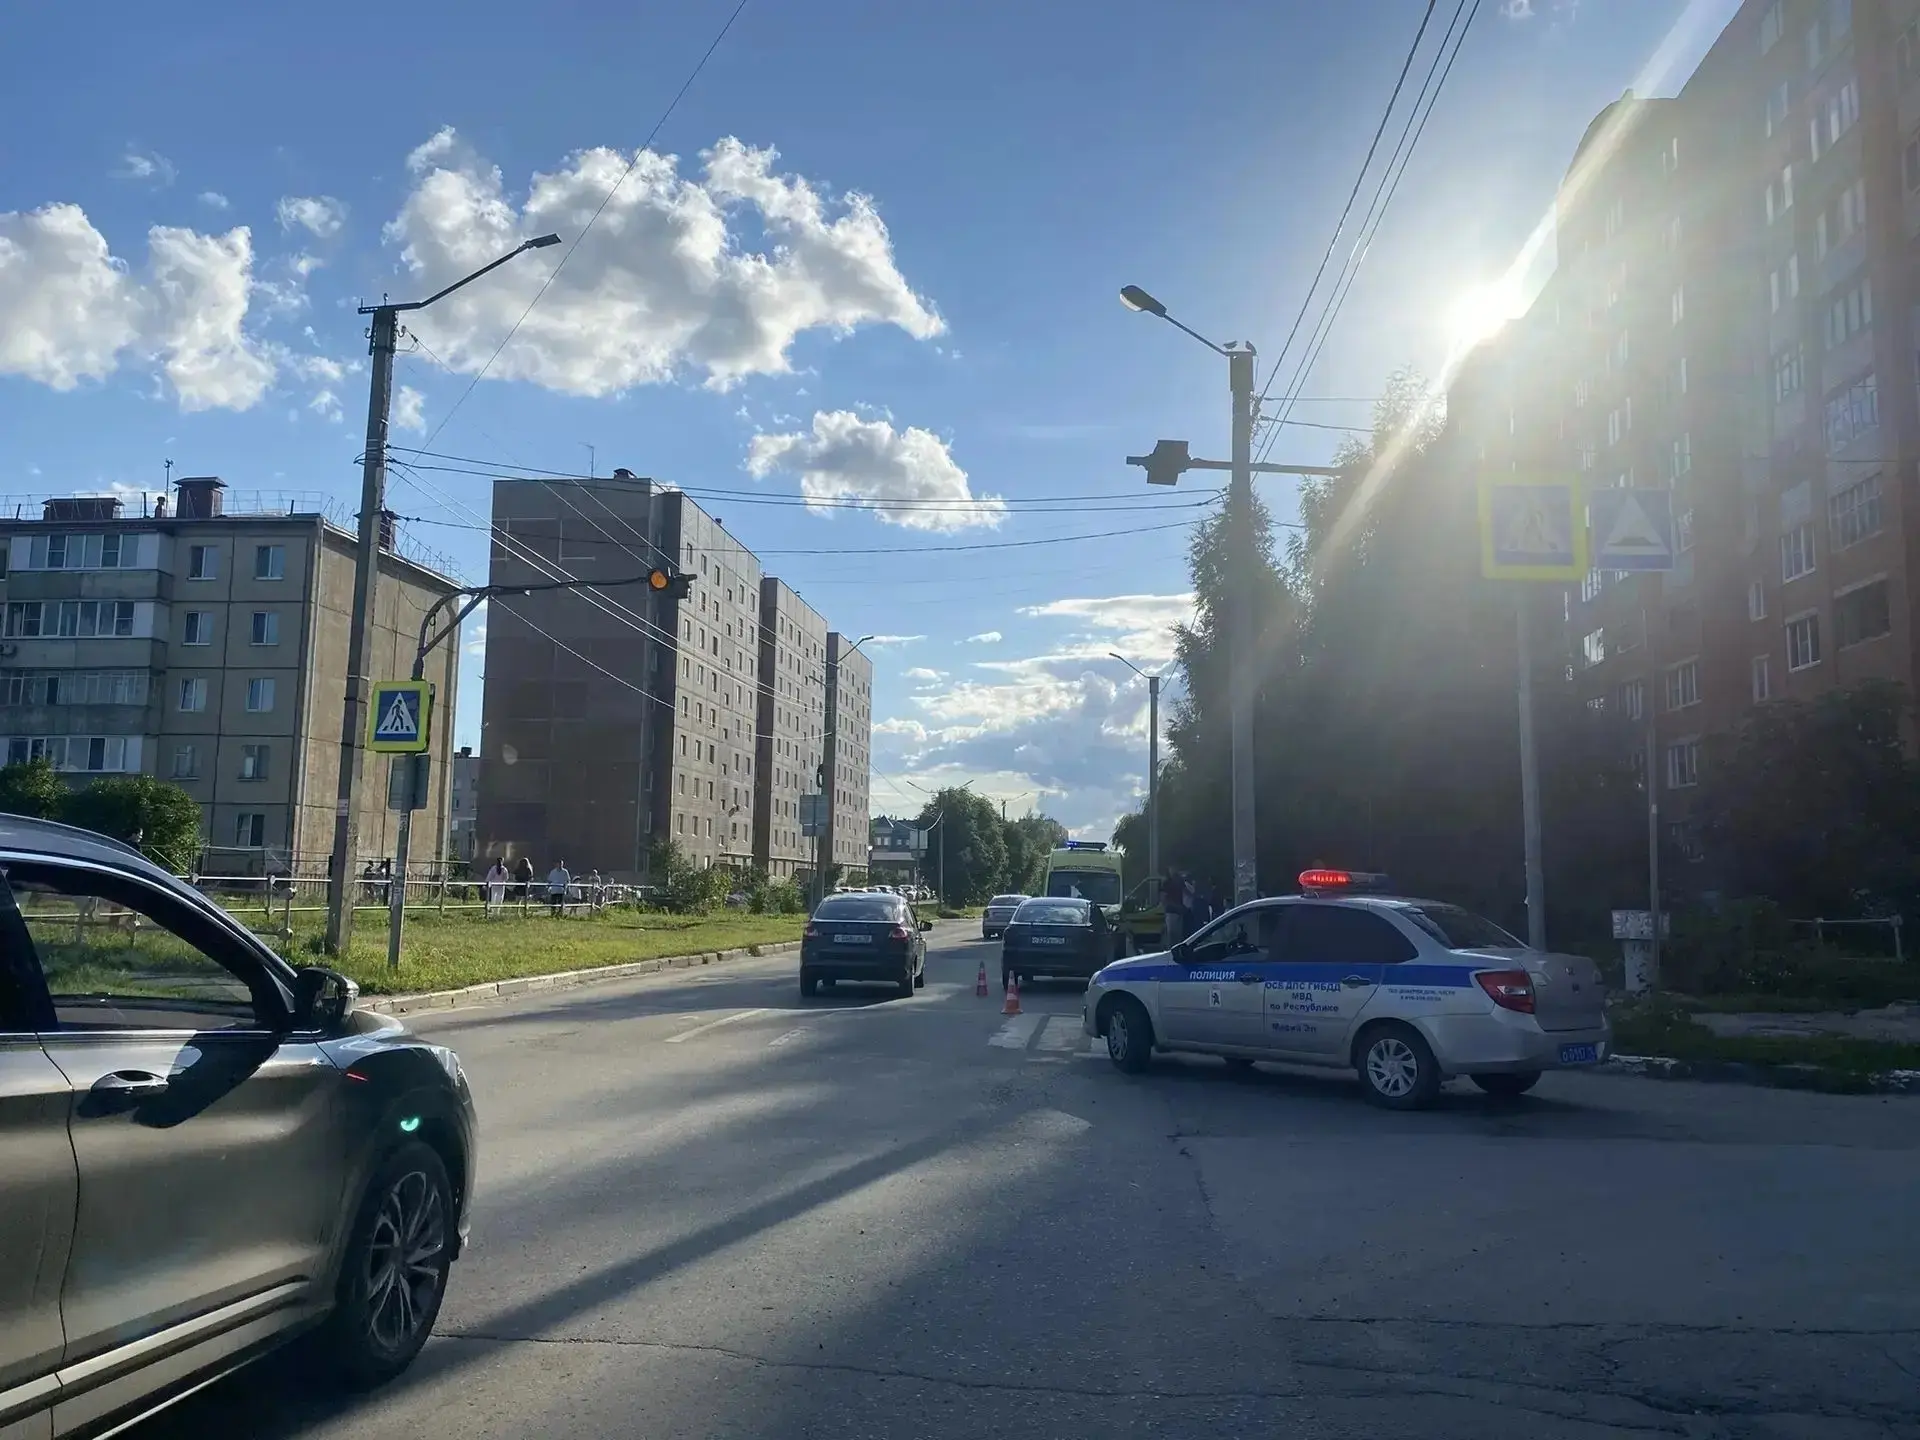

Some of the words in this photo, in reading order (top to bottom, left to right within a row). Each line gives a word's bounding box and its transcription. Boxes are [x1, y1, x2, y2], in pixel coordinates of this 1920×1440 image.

[1189, 970, 1235, 981] ПОЛИЦИЯ
[1286, 981, 1305, 991] ДПС
[1307, 982, 1342, 993] ГИБДД
[1291, 992, 1313, 1002] МВД
[1269, 1003, 1281, 1011] по
[1283, 1002, 1339, 1013] Республике
